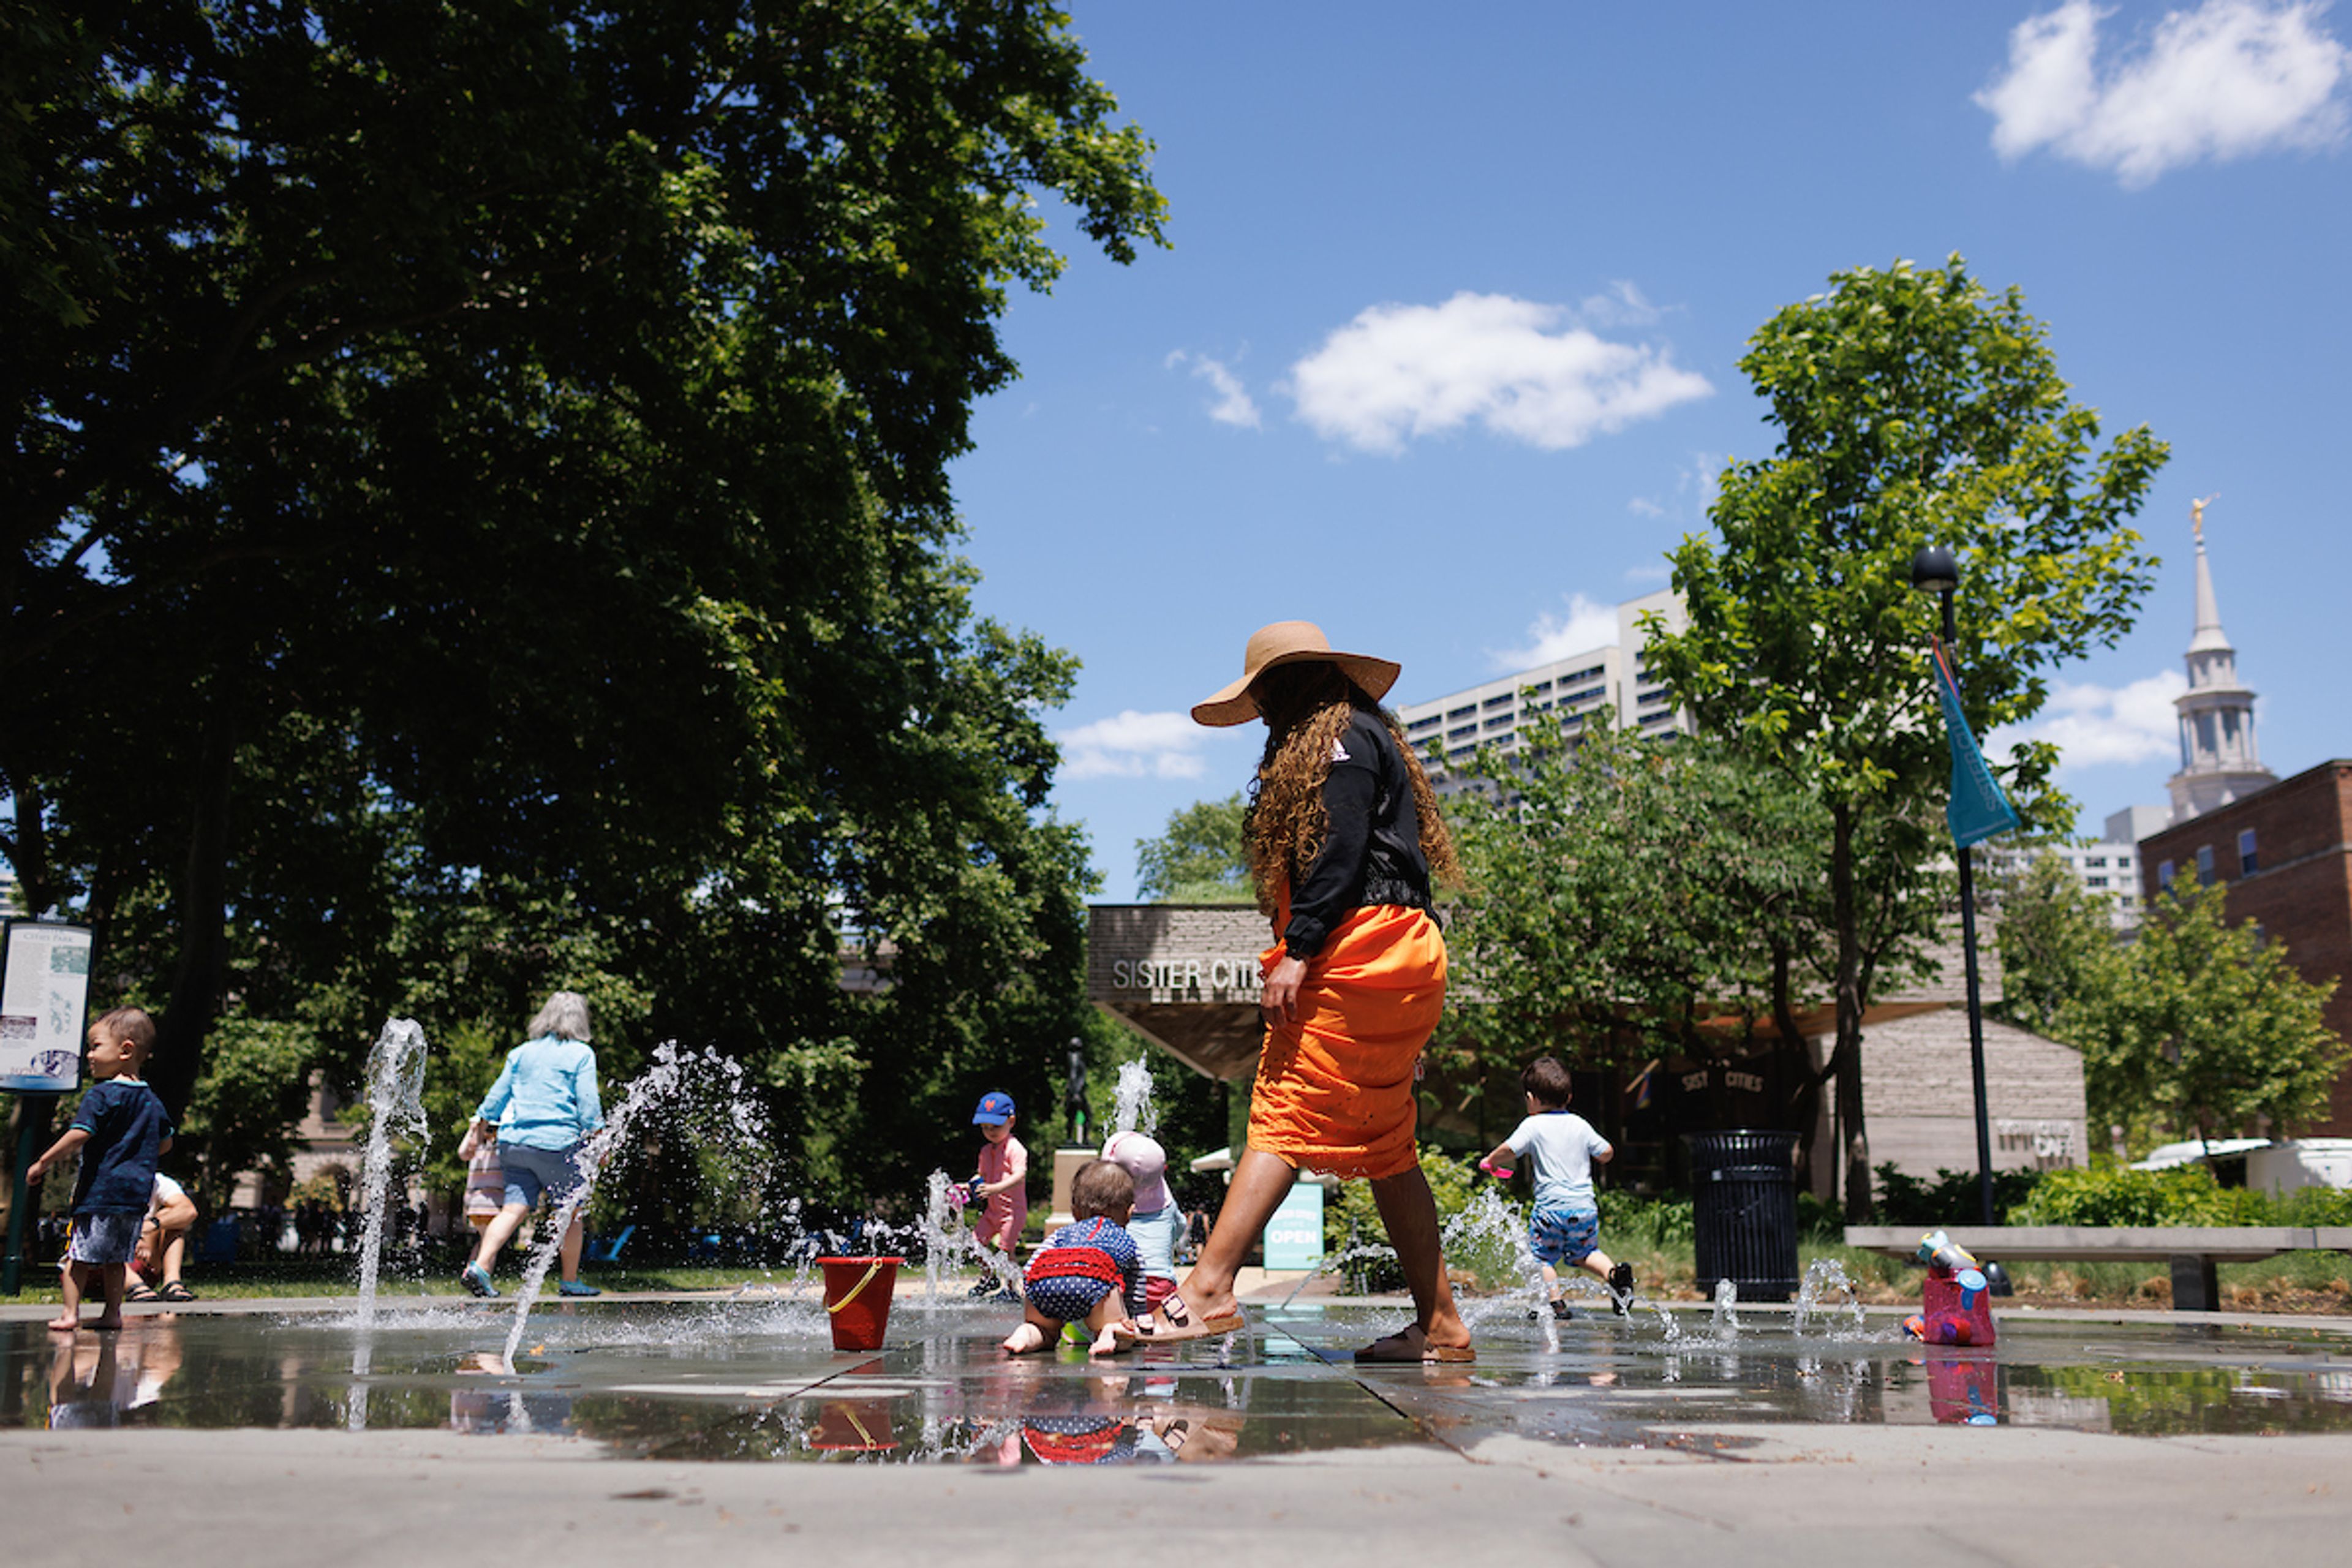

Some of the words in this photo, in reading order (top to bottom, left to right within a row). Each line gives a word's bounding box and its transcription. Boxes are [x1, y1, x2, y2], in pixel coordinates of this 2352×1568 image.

[1113, 959, 1201, 989] SISTER
[1211, 959, 1264, 989] CITI
[1270, 1230, 1317, 1244] OPEN
